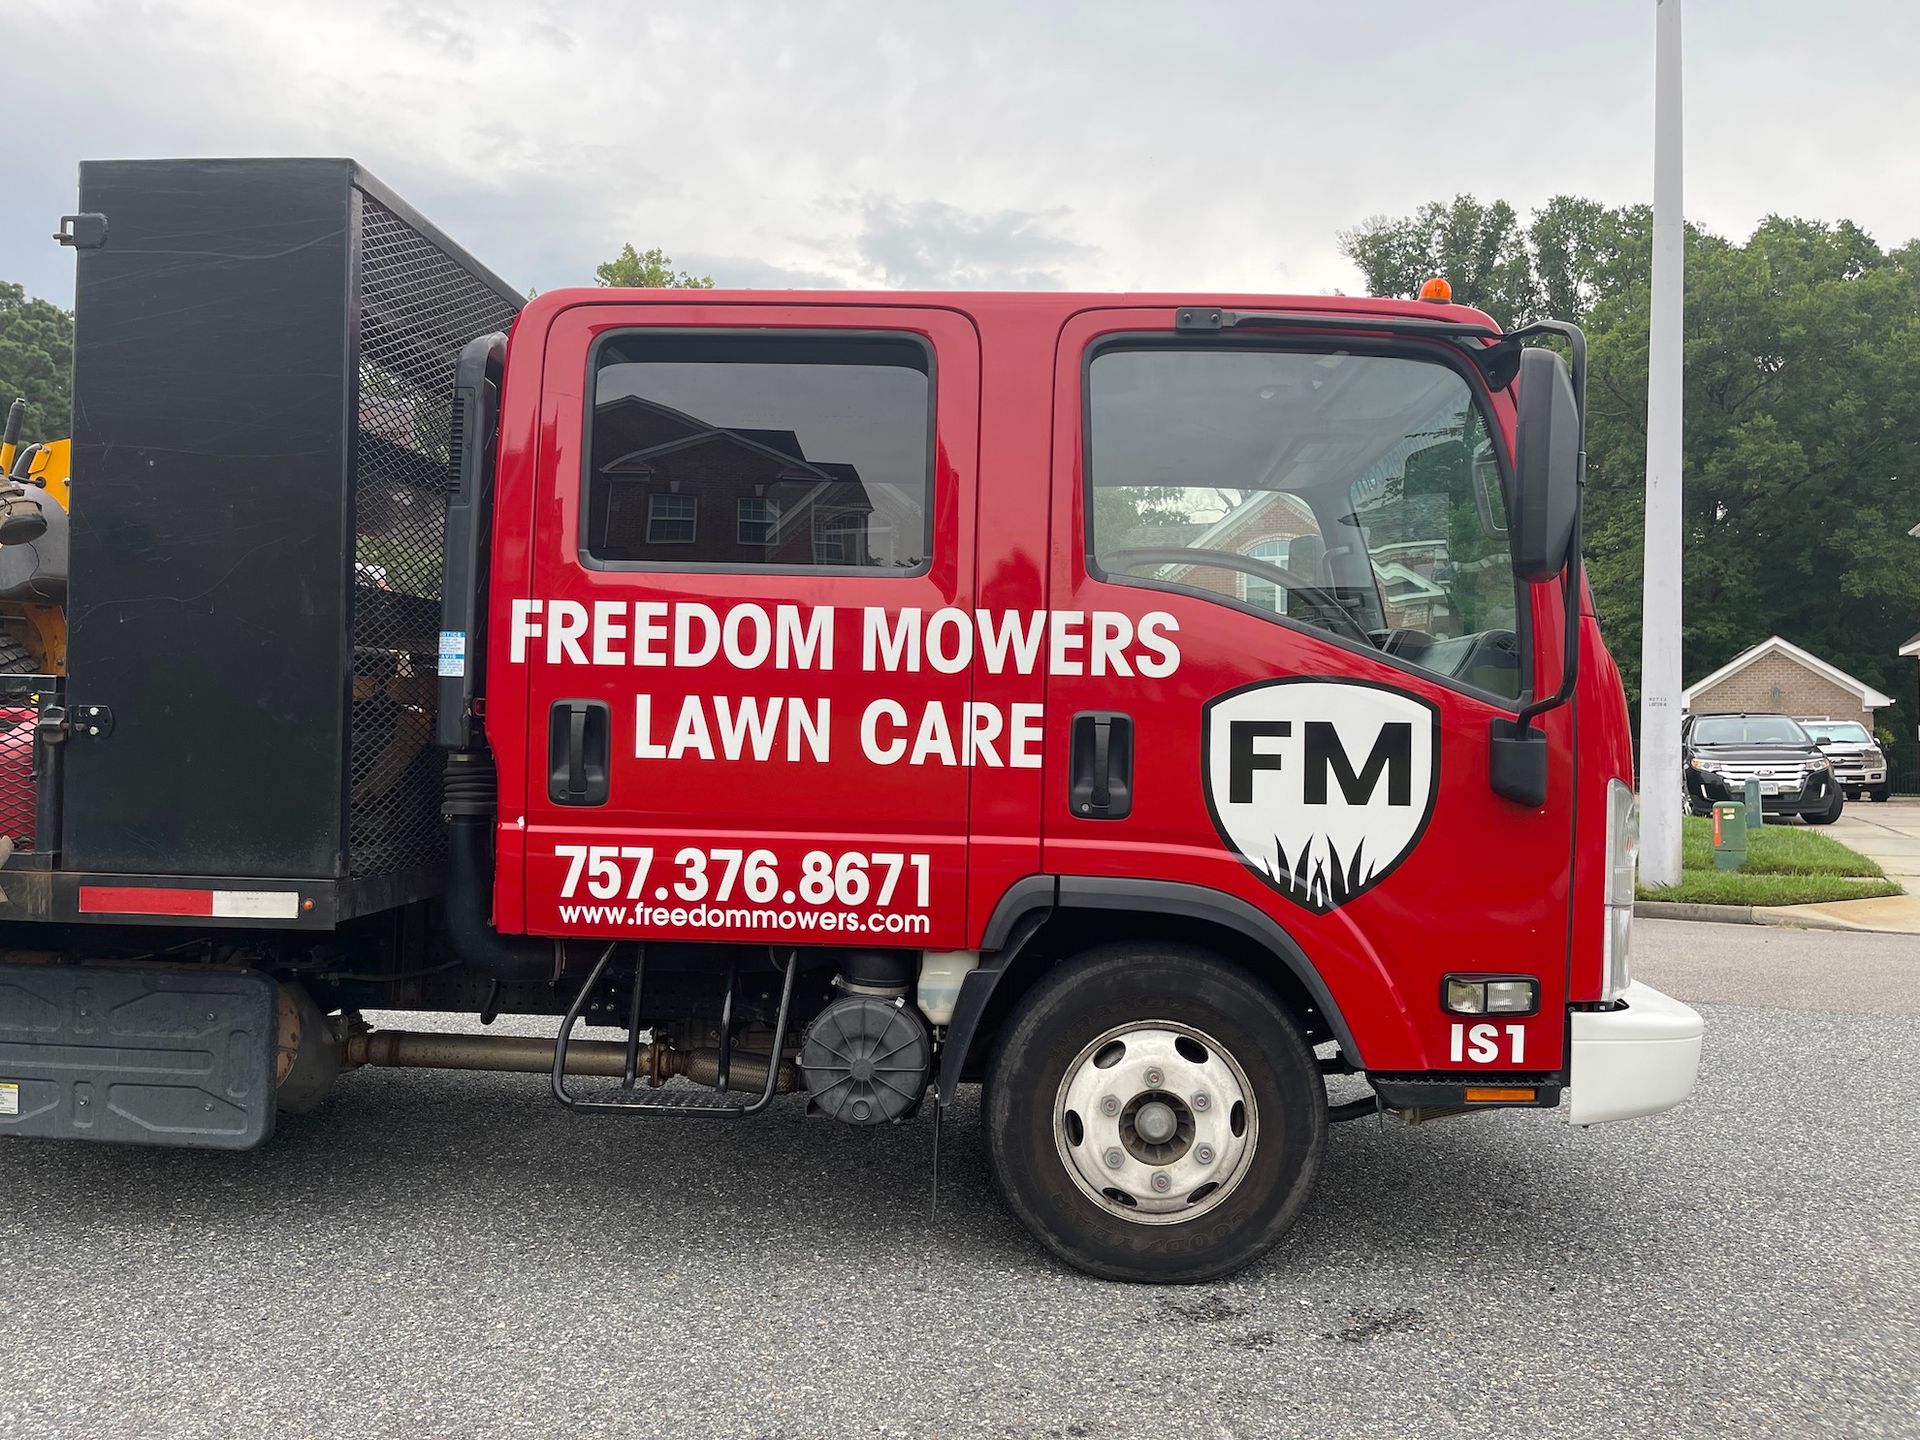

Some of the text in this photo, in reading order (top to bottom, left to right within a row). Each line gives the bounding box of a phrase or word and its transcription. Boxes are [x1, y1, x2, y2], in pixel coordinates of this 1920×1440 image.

[511, 598, 1181, 679] FREEDOM MOWERS
[635, 694, 1044, 769] LAWN CARE
[1230, 721, 1411, 806] FM
[555, 845, 930, 907] 757.376.8671
[558, 902, 930, 934] www.freedommowers.com
[1450, 1023, 1525, 1064] IS1
